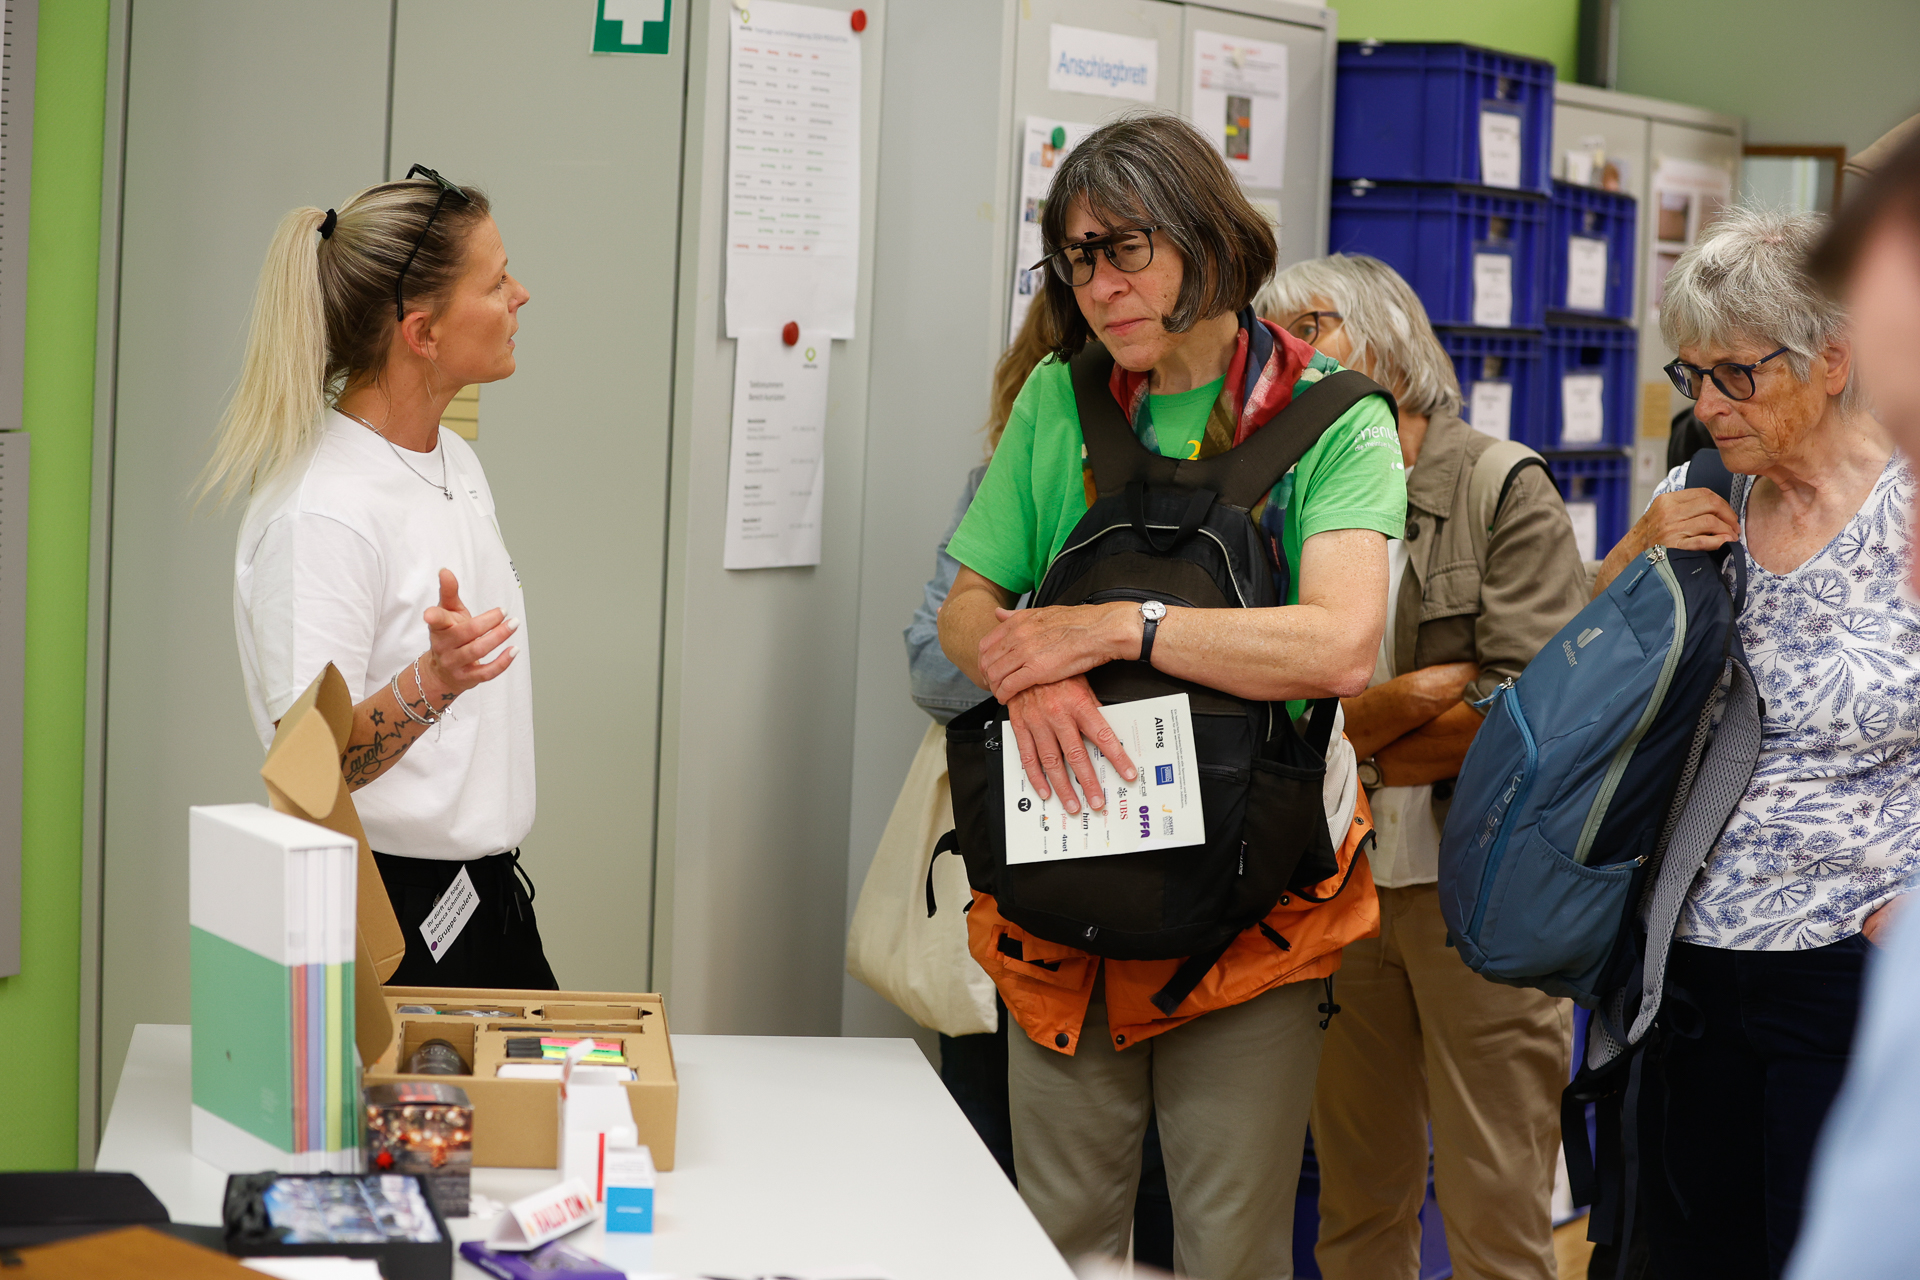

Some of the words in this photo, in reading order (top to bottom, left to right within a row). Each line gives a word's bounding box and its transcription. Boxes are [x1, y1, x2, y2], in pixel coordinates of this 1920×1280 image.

[1057, 50, 1147, 87] Anschlagbrett
[1562, 640, 1578, 667] deuter
[1155, 717, 1164, 748] Alltag
[1021, 800, 1029, 810] TY
[1118, 799, 1128, 820] UBS
[1479, 812, 1498, 848] BIKE
[430, 913, 449, 935] Rebecca
[437, 916, 457, 943] Gruppe
[456, 892, 473, 916] Violett
